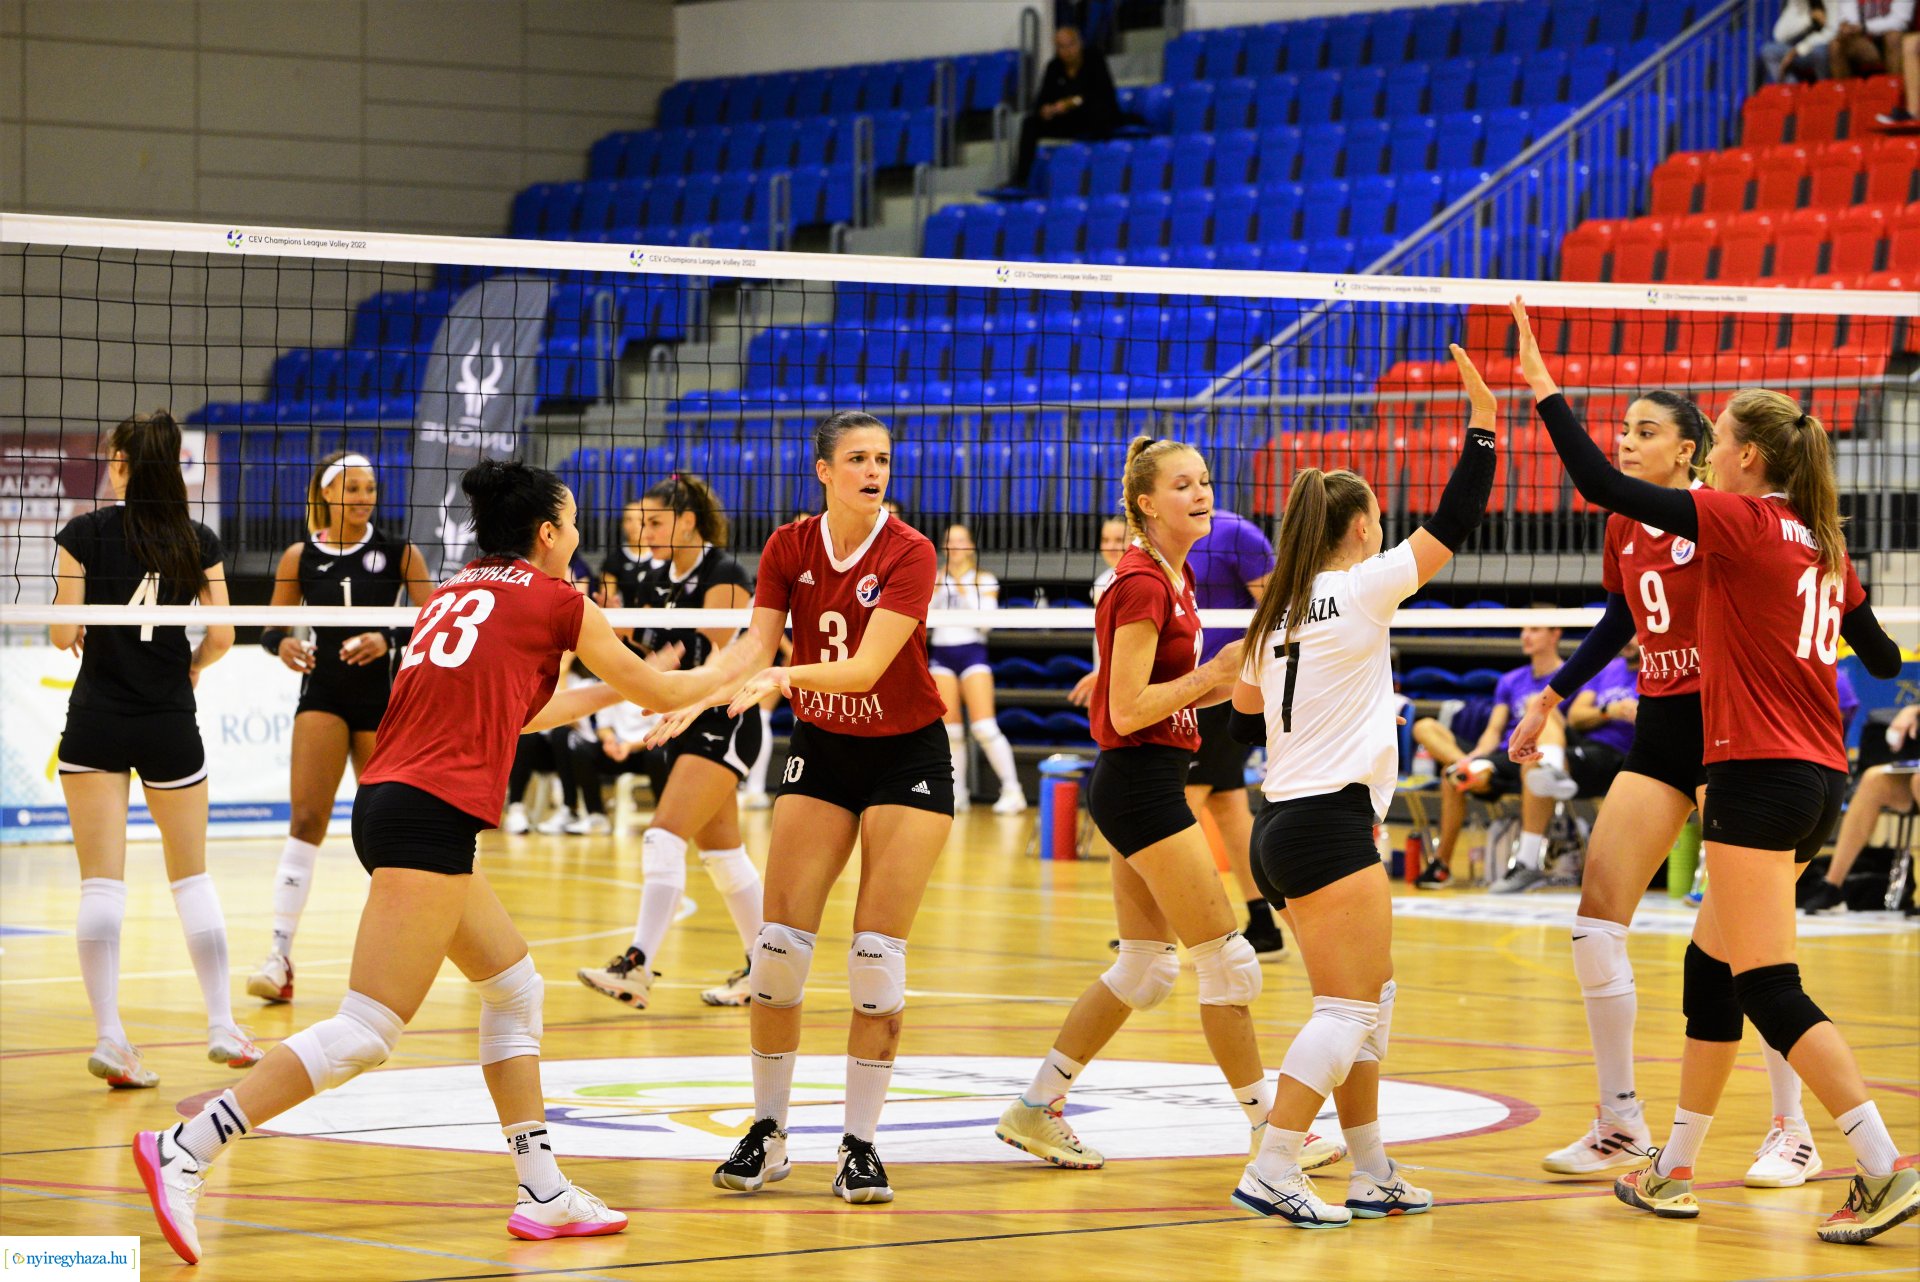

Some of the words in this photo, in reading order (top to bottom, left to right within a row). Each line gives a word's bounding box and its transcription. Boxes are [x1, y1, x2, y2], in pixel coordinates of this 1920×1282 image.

[248, 235, 263, 244] CEV
[264, 236, 302, 247] Champions
[303, 238, 327, 248] League
[329, 240, 350, 249] Volley
[350, 241, 367, 249] 2022
[649, 254, 662, 263] CEV
[664, 255, 698, 265] Champions
[699, 258, 721, 267] League
[722, 258, 741, 268] Volley
[741, 259, 756, 267] 2022
[1027, 271, 1058, 280] Champions
[1059, 273, 1080, 281] League
[1639, 570, 1671, 634] 9
[1796, 566, 1844, 665] 16
[401, 588, 496, 671] 23
[818, 610, 849, 663] 3
[799, 687, 883, 718] FATUM
[1273, 641, 1300, 733] 7
[782, 755, 805, 785] 10
